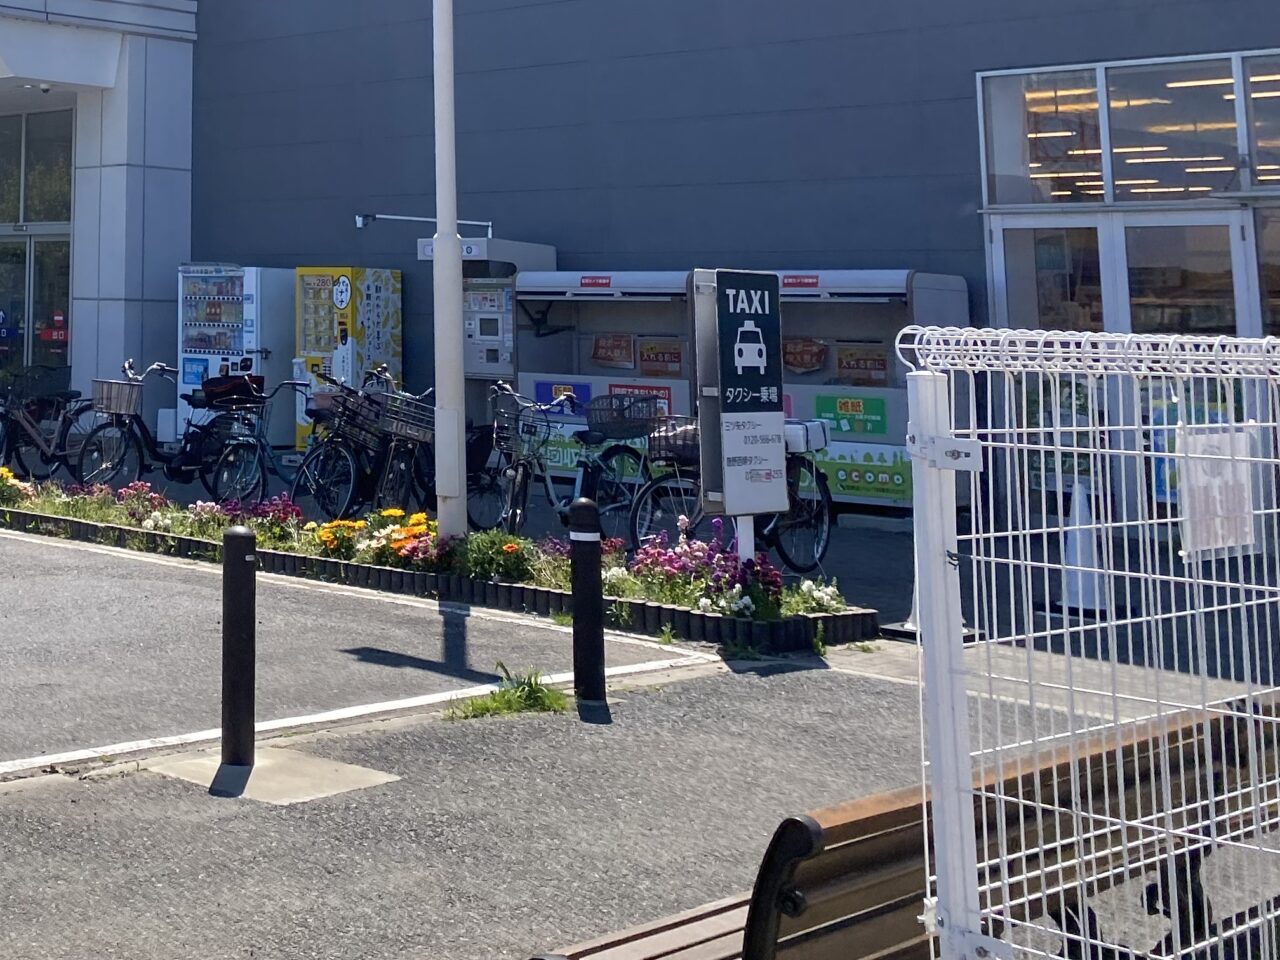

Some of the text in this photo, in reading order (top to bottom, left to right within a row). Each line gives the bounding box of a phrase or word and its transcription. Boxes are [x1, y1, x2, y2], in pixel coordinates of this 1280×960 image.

[725, 289, 770, 315] TAXI
[725, 386, 778, 403] タクシー乗場
